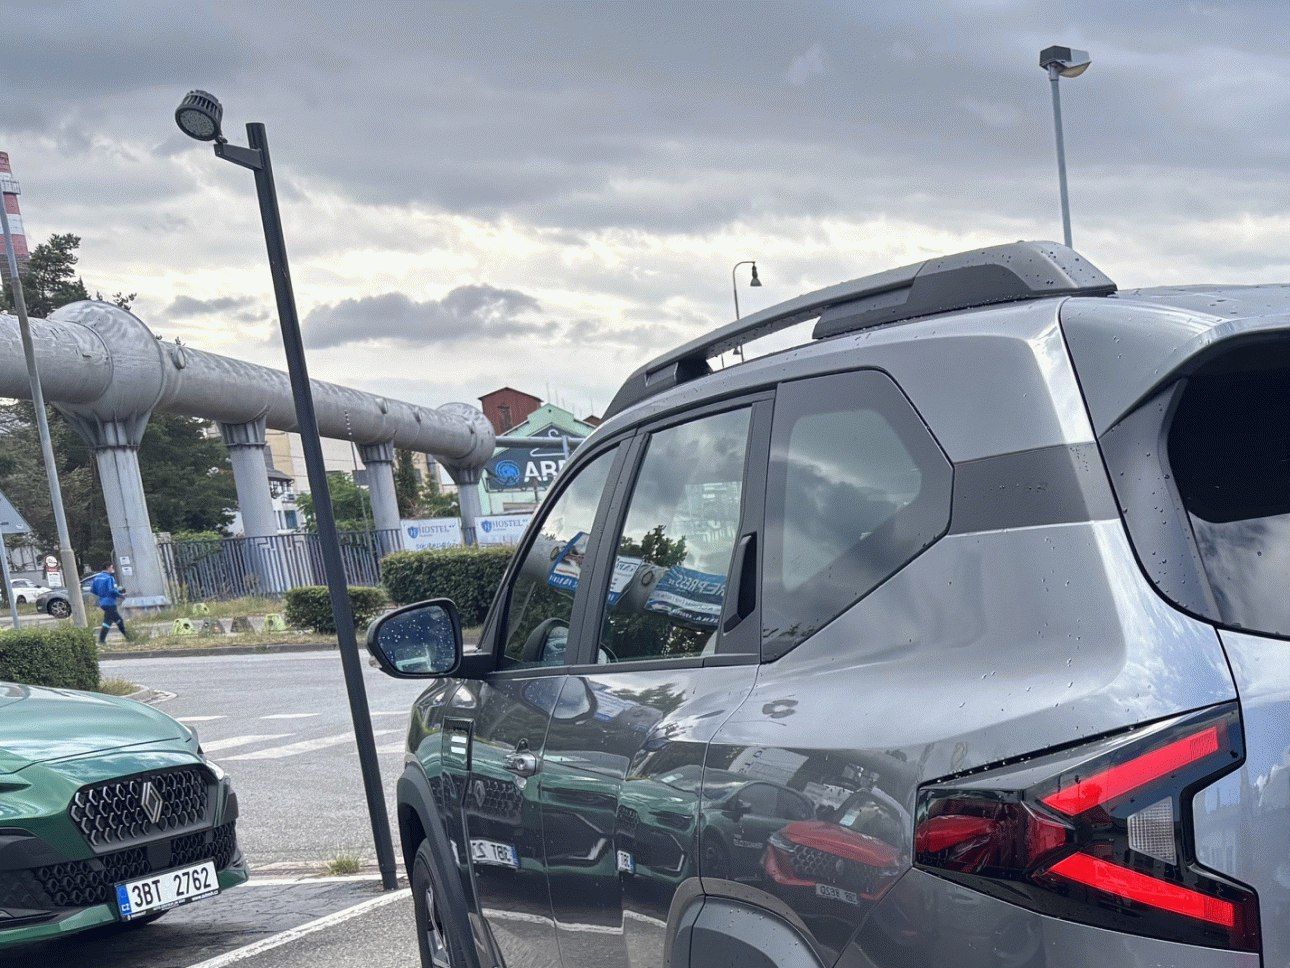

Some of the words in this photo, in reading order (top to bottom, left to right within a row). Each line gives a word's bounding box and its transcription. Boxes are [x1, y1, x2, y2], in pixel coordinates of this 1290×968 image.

[132, 879, 162, 907] 3BT
[173, 867, 211, 897] 2762
[121, 903, 130, 911] CZ
